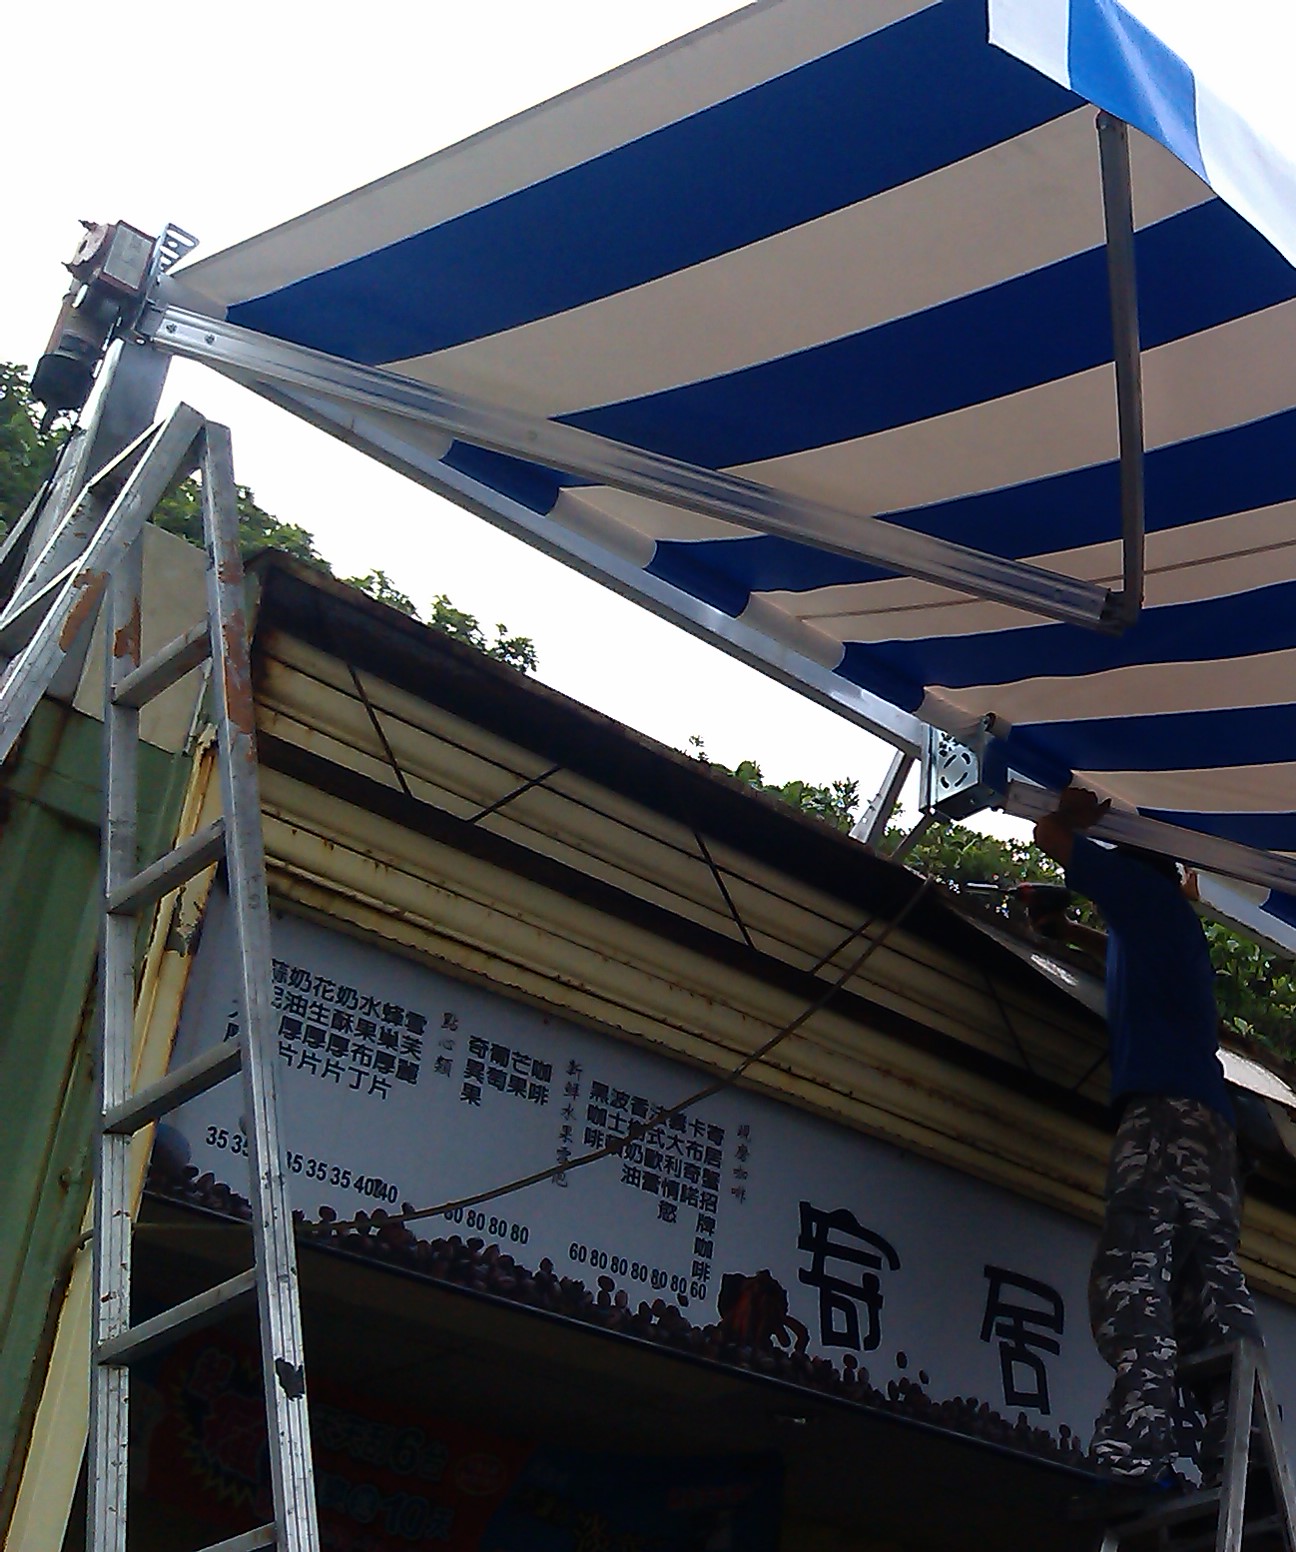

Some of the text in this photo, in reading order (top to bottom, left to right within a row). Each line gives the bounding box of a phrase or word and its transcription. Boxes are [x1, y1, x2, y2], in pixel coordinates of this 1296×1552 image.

[297, 976, 336, 1075] 花生厚片
[321, 986, 357, 1083] 奶酥厚片
[347, 996, 381, 1090] 水果布丁
[368, 1003, 404, 1099] 蜂巢厚片
[460, 1035, 489, 1106] 奇異果
[486, 1043, 510, 1091] 葡萄
[507, 1051, 532, 1099] 芒果
[528, 1059, 554, 1105] 咖啡
[583, 1080, 609, 1150] 黑咖啡
[206, 1126, 229, 1149] 35
[306, 1159, 328, 1181] 35
[330, 1167, 352, 1189] 35
[353, 1175, 375, 1197] 40
[680, 1119, 707, 1209] 卡布奇諾
[466, 1209, 486, 1231] 80
[488, 1216, 508, 1238] 80
[510, 1223, 530, 1245] 80
[569, 1242, 707, 1300] 60 80 80 80 80 80 60
